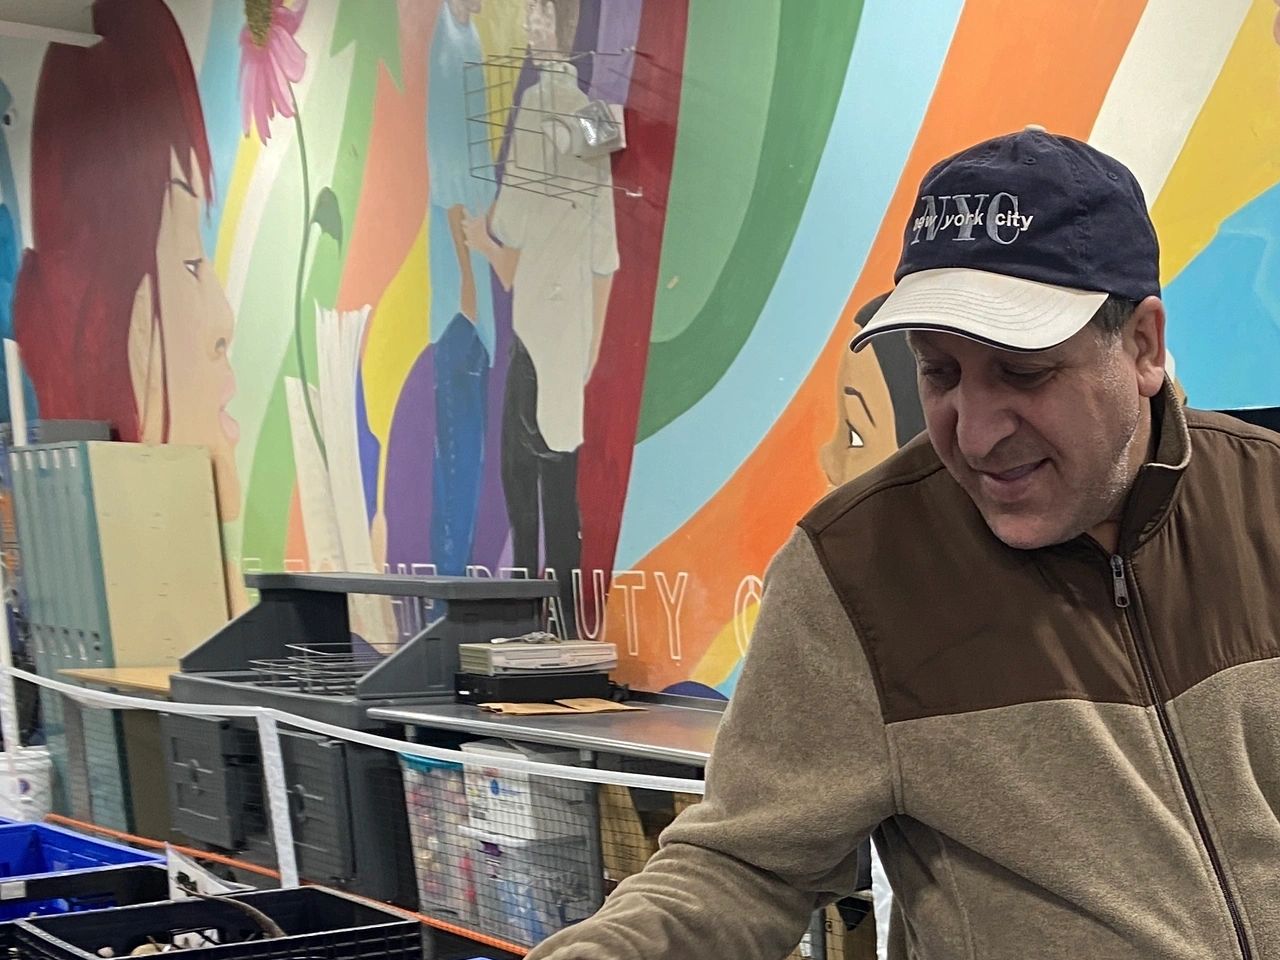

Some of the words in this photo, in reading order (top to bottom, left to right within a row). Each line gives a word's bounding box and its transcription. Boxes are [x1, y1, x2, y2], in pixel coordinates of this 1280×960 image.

[911, 191, 1020, 245] NYC
[940, 208, 984, 230] york
[995, 210, 1034, 231] city
